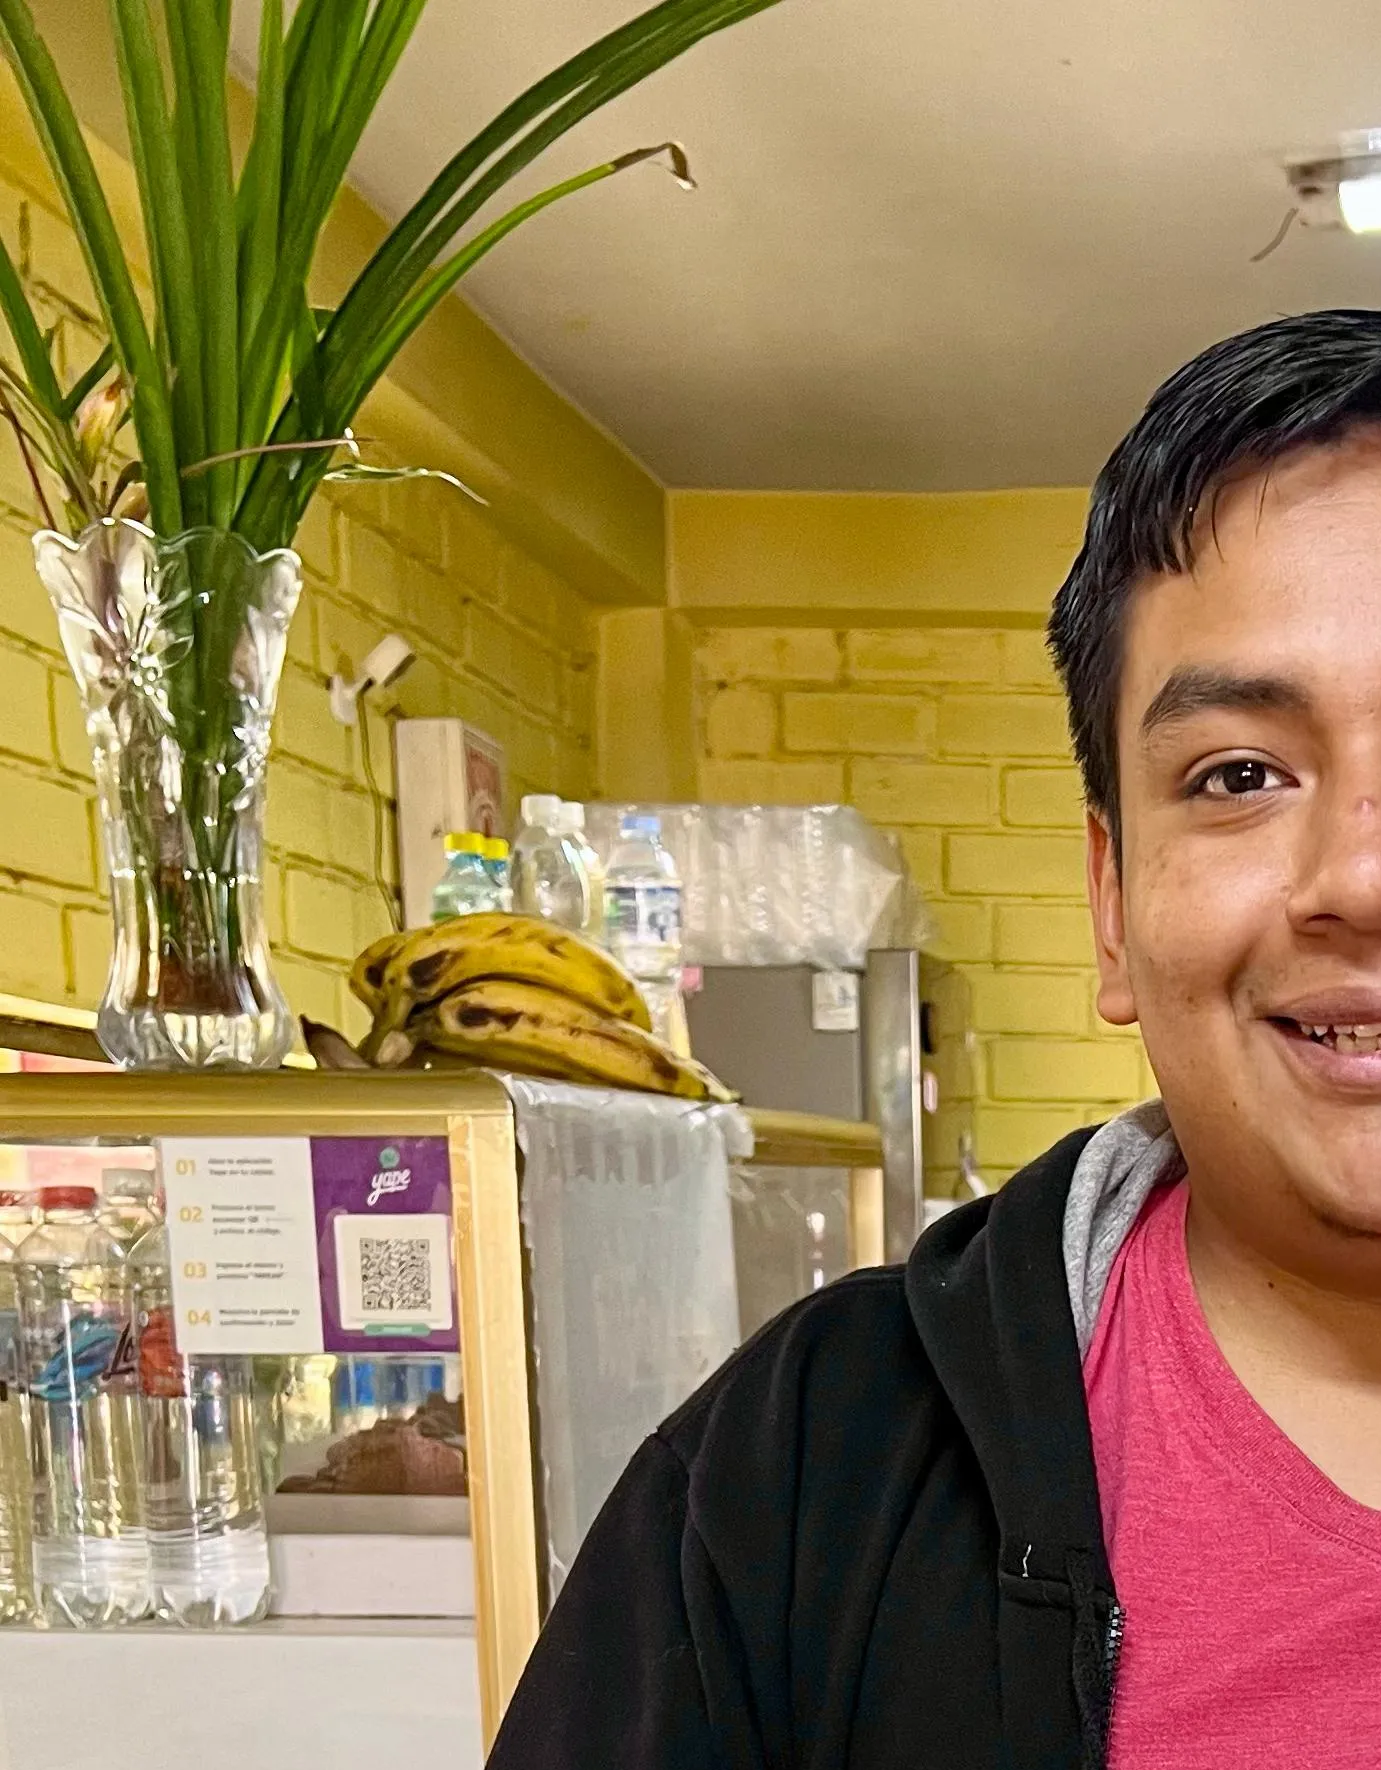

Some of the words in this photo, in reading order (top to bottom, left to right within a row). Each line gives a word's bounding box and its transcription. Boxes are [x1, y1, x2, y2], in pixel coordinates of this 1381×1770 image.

[176, 1159, 196, 1175] 01
[367, 1168, 411, 1206] yape
[179, 1206, 204, 1223] 02
[184, 1262, 207, 1279] 03
[187, 1310, 212, 1326] 04
